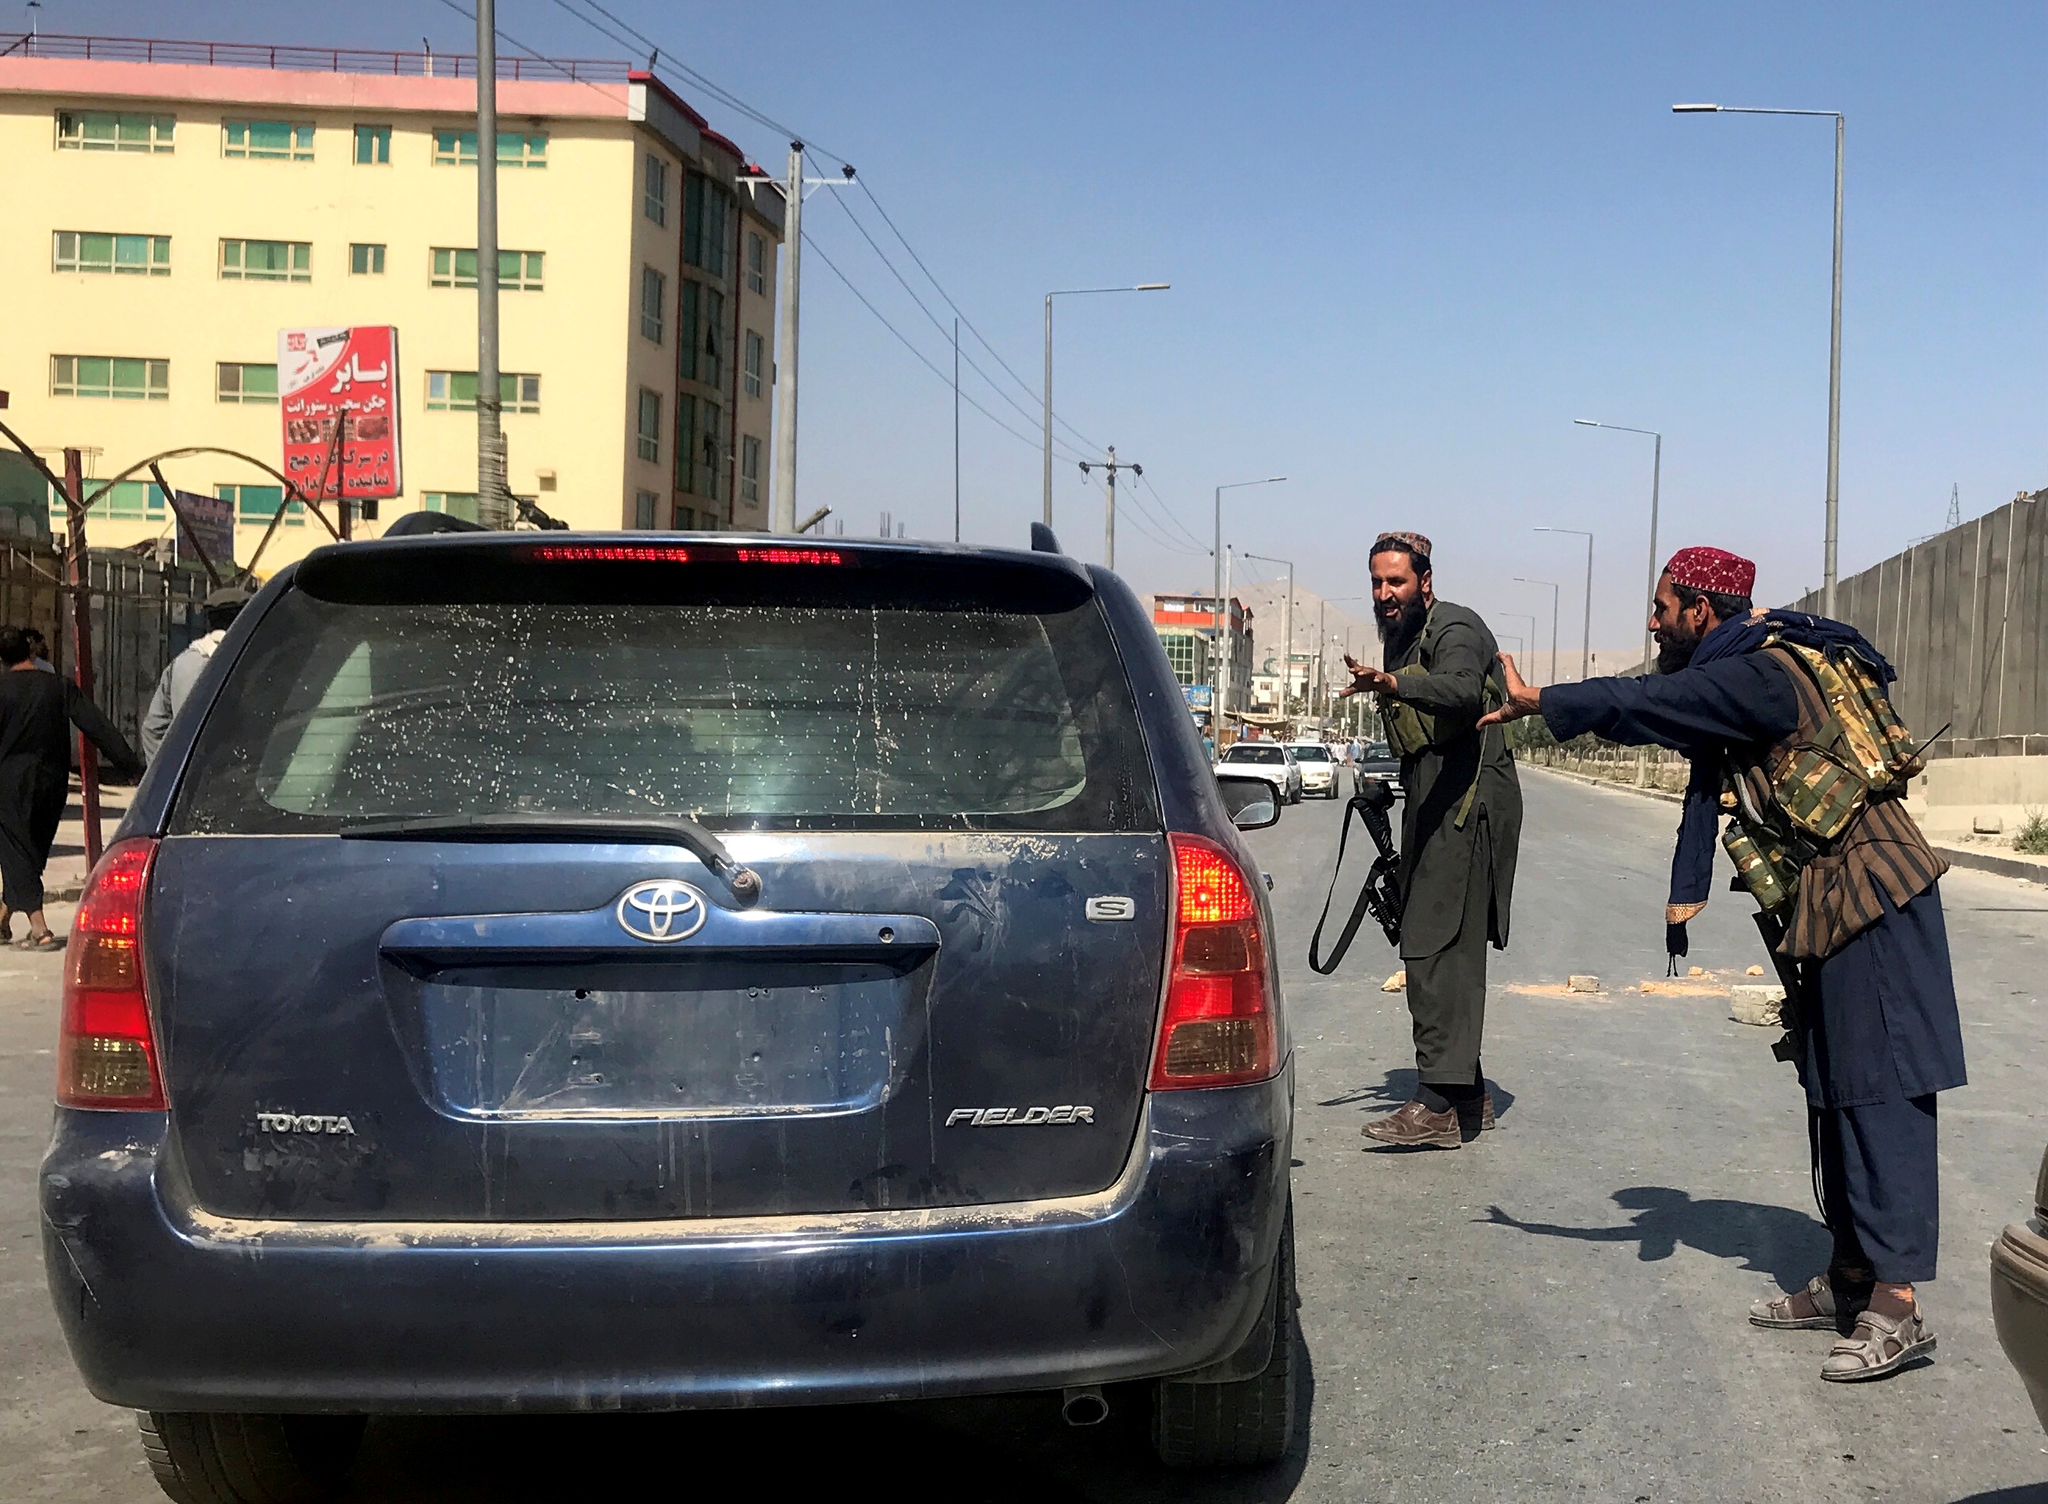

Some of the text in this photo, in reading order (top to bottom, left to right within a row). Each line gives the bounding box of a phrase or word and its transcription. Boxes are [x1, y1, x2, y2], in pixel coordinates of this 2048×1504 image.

[330, 352, 388, 394] بابر
[1093, 899, 1129, 918] S
[257, 1112, 356, 1135] TOYOTA
[945, 1104, 1095, 1127] FIELDER
